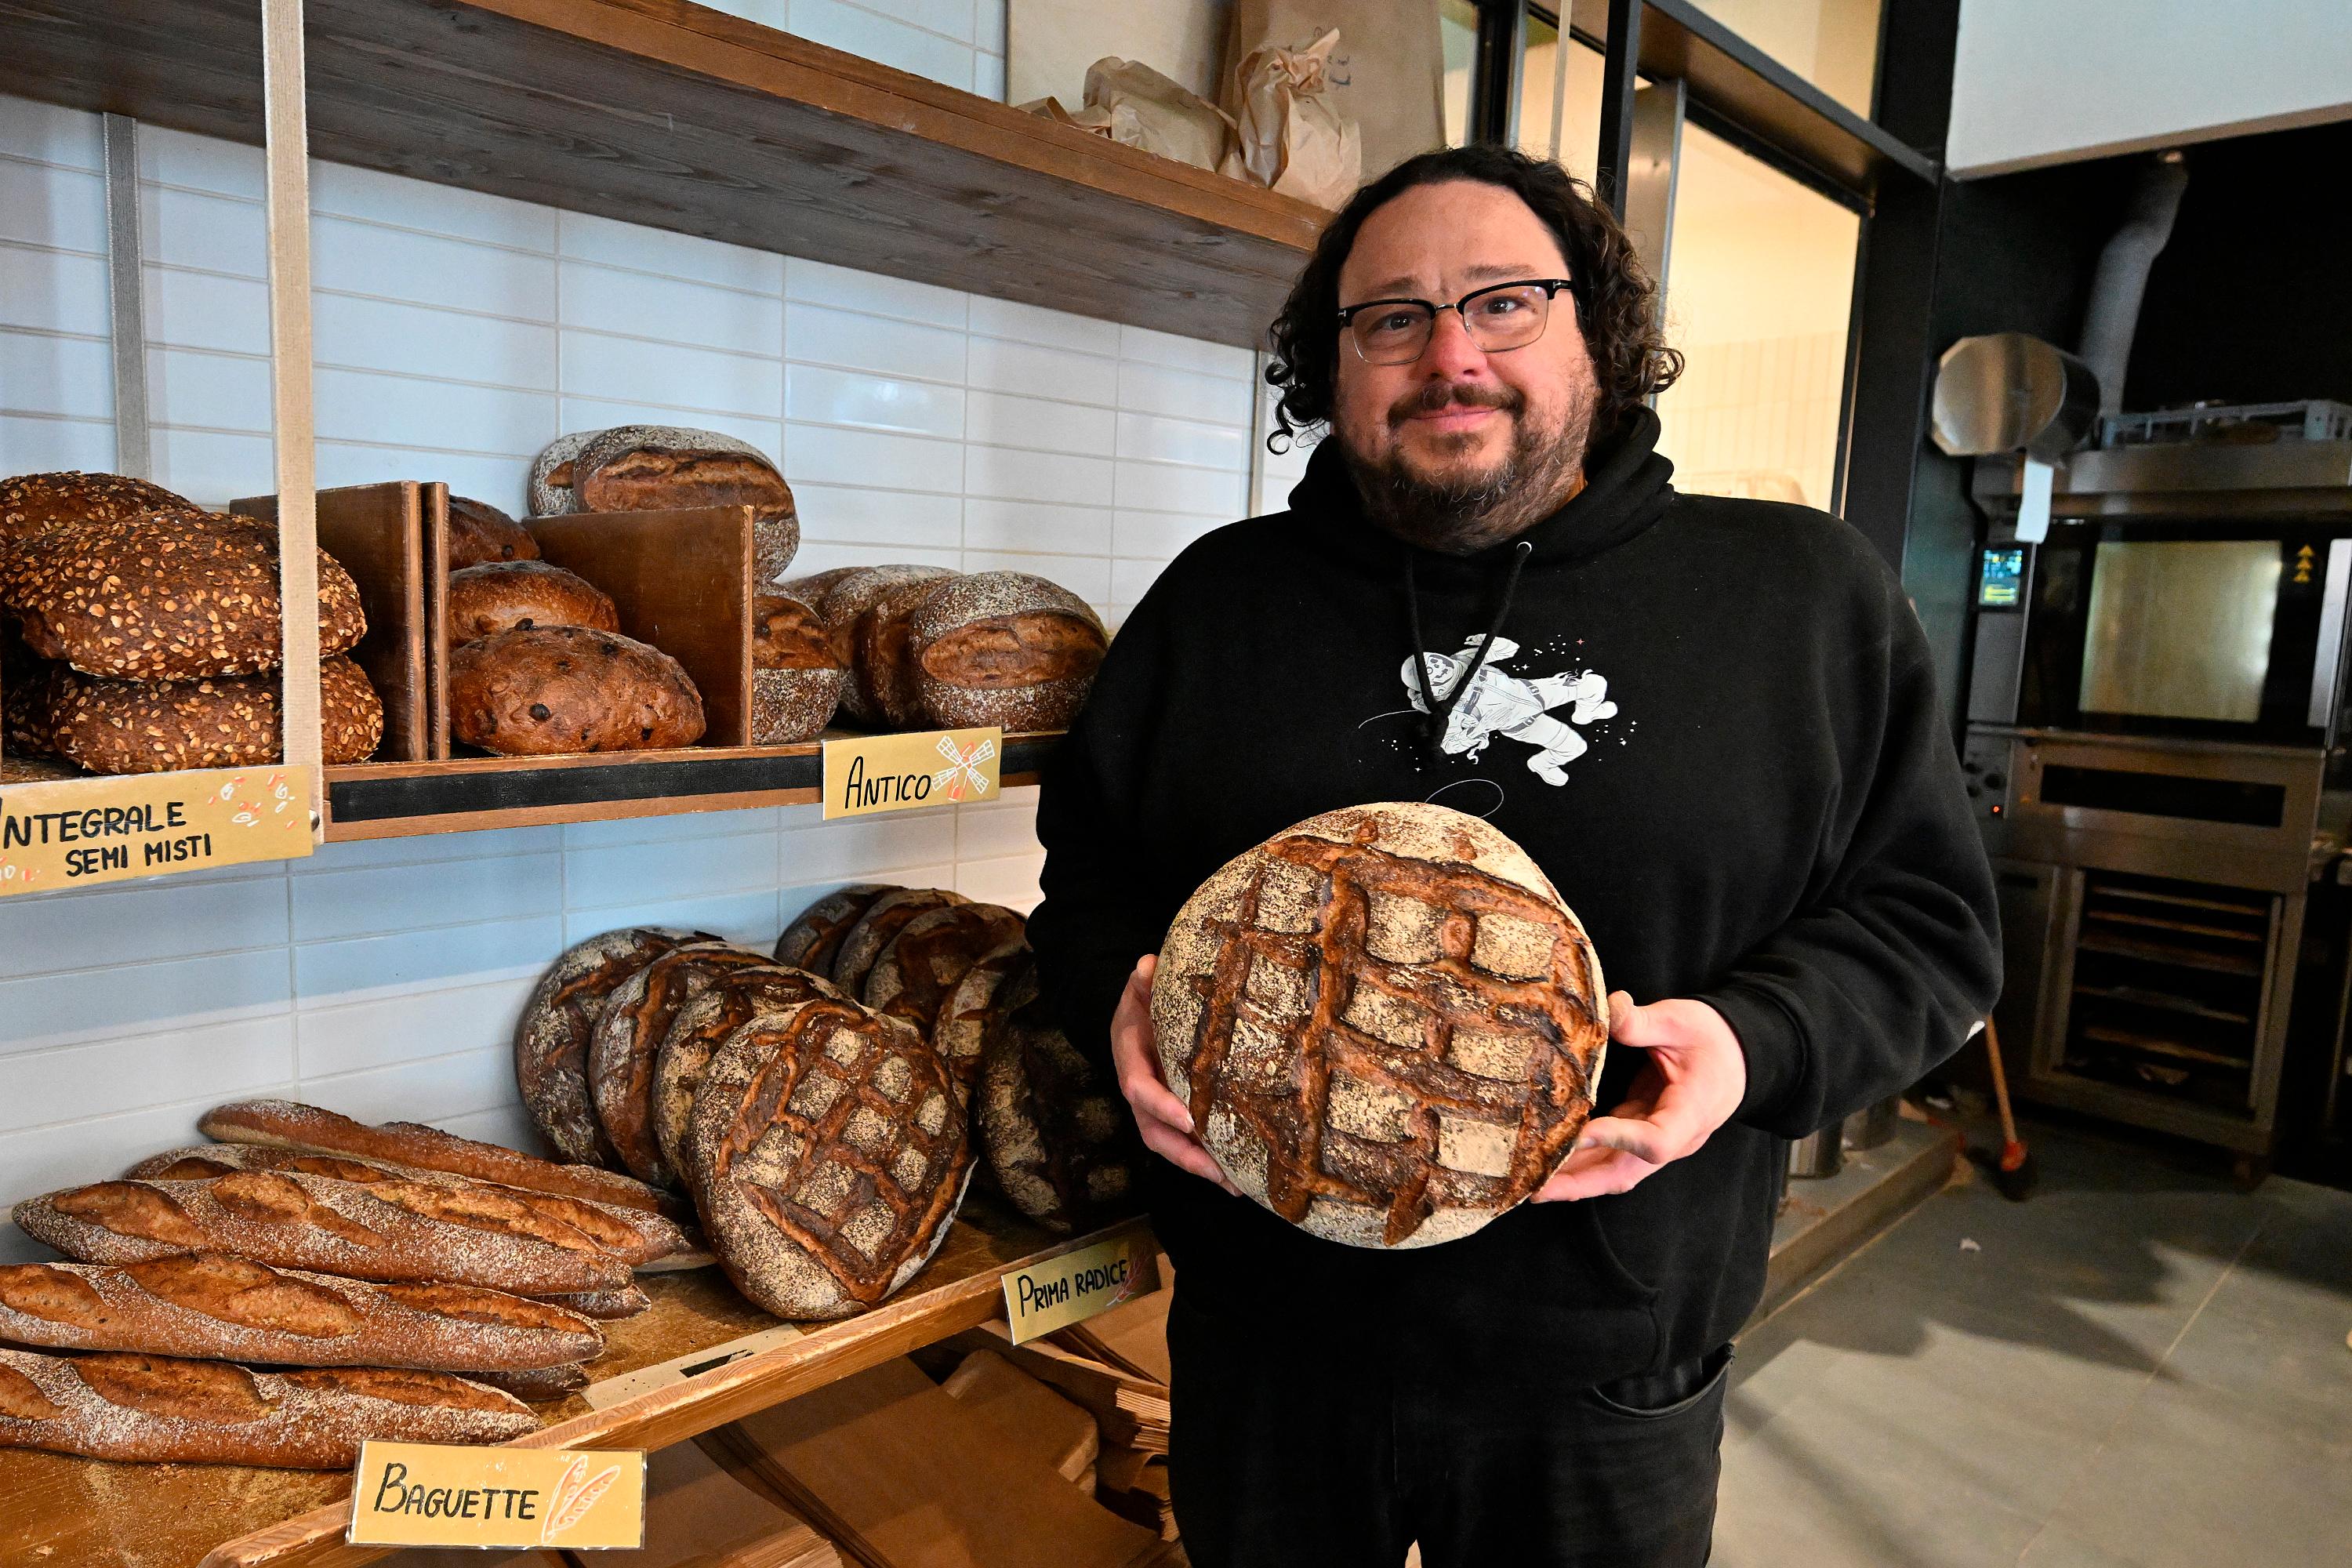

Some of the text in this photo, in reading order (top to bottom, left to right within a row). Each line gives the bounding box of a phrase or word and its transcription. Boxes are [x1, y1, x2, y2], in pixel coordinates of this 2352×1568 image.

[844, 756, 931, 809] ANTICO
[0, 797, 187, 849] NTEGRALE
[66, 833, 212, 877] SEMI MISTI
[1017, 1259, 1128, 1317] PRIMA RADICE
[374, 1462, 539, 1520] BAGUETTE
